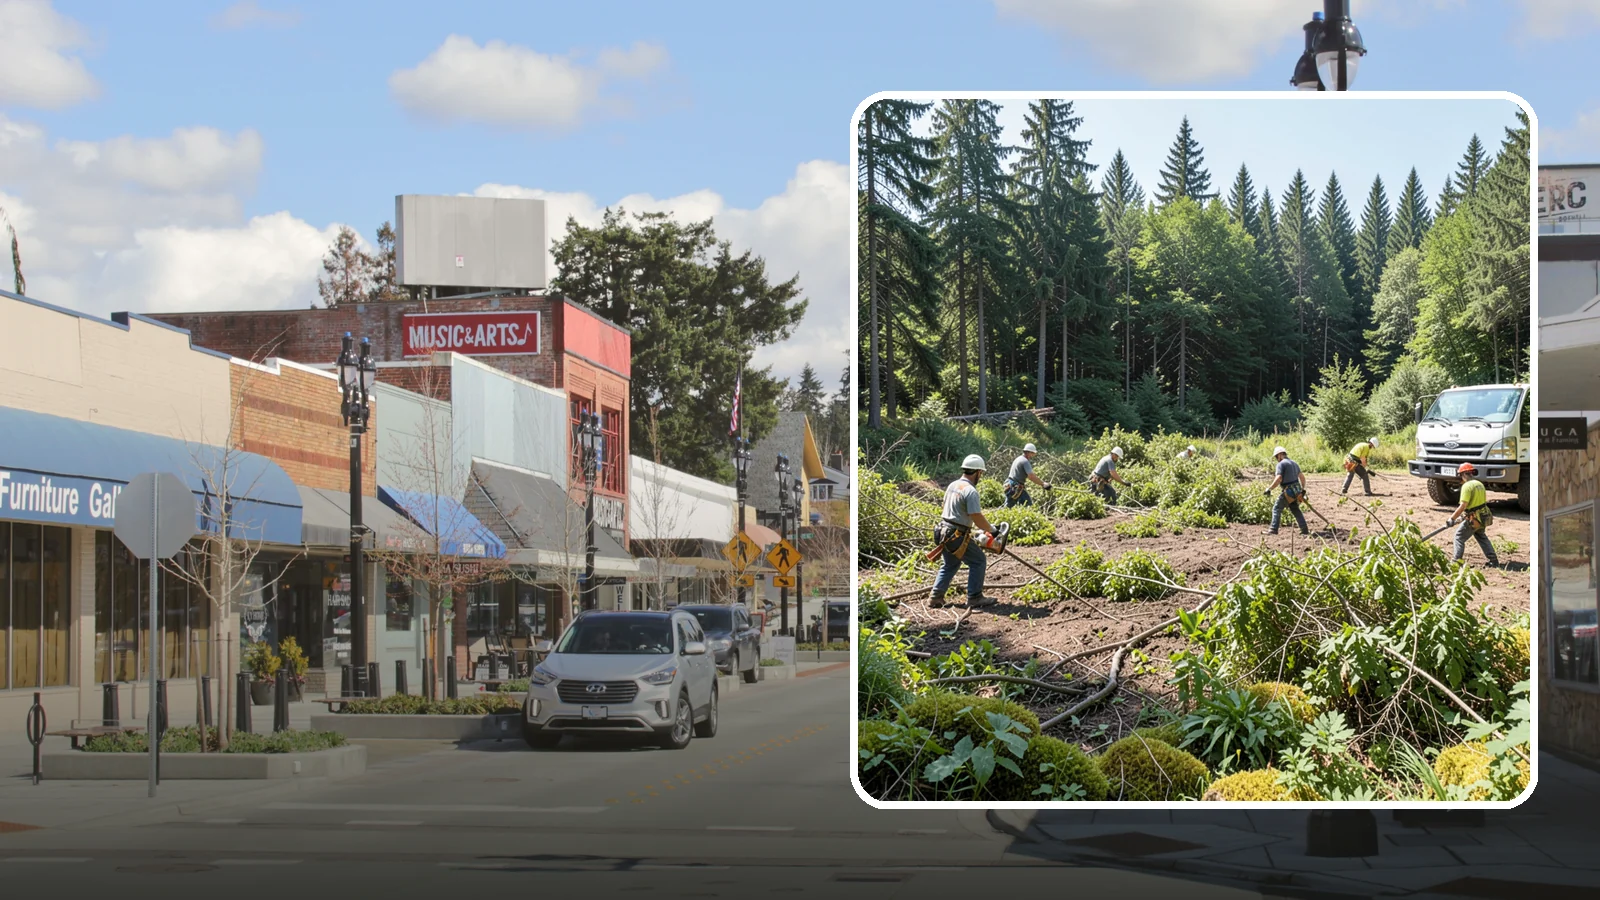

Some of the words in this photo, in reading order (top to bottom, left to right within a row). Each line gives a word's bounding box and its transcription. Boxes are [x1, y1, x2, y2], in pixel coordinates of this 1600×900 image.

[0, 471, 79, 515] Furniture
[89, 482, 122, 519] Gal
[453, 563, 480, 575] SUSHI
